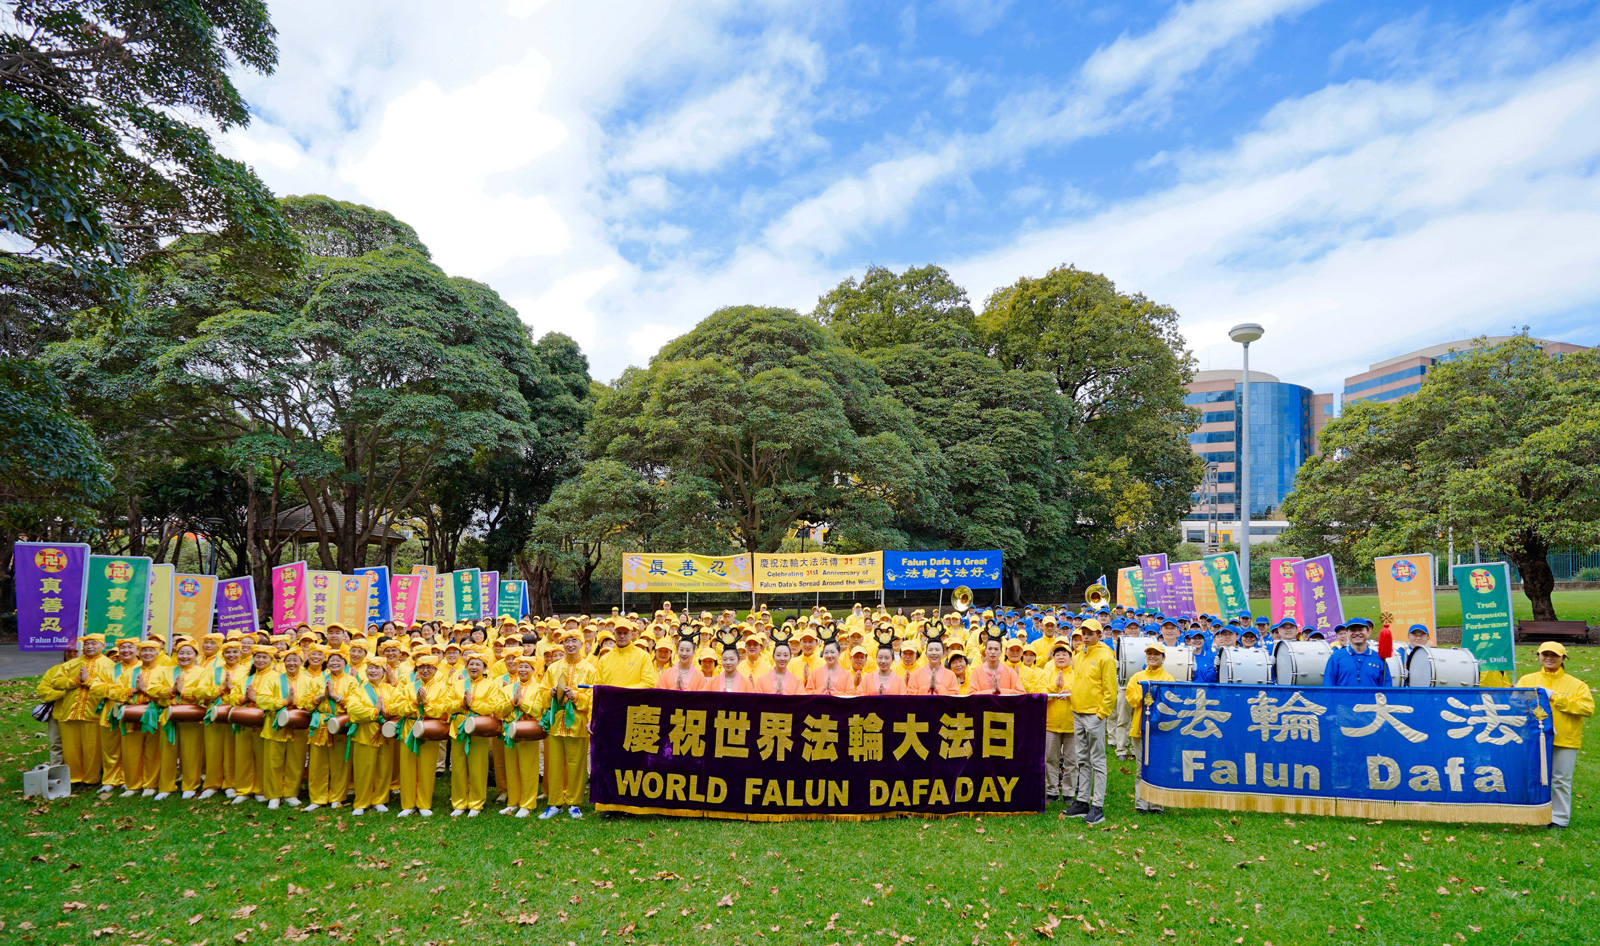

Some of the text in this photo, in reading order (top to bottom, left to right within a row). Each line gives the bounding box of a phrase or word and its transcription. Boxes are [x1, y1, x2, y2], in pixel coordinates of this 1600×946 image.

[901, 558, 927, 566] Falun
[930, 558, 951, 566] Dafa
[963, 558, 988, 566] Great
[905, 567, 985, 578] 法輪大法好
[39, 577, 64, 633] 真善忍
[312, 592, 327, 626] 真善忍
[461, 585, 474, 612] 真善忍
[1312, 585, 1331, 631] 真善忍
[1383, 597, 1431, 607] Compassion
[1395, 588, 1420, 597] Truth
[1476, 601, 1497, 609] Truth
[175, 601, 197, 636] 真善
[1465, 611, 1507, 621] Compassion
[622, 704, 1016, 763] 慶祝世界法輪大法日
[1156, 688, 1528, 746] 法輪大法
[614, 769, 728, 804] WORLD
[744, 777, 849, 807] FALUN
[1181, 750, 1508, 793] Falun Dafa
